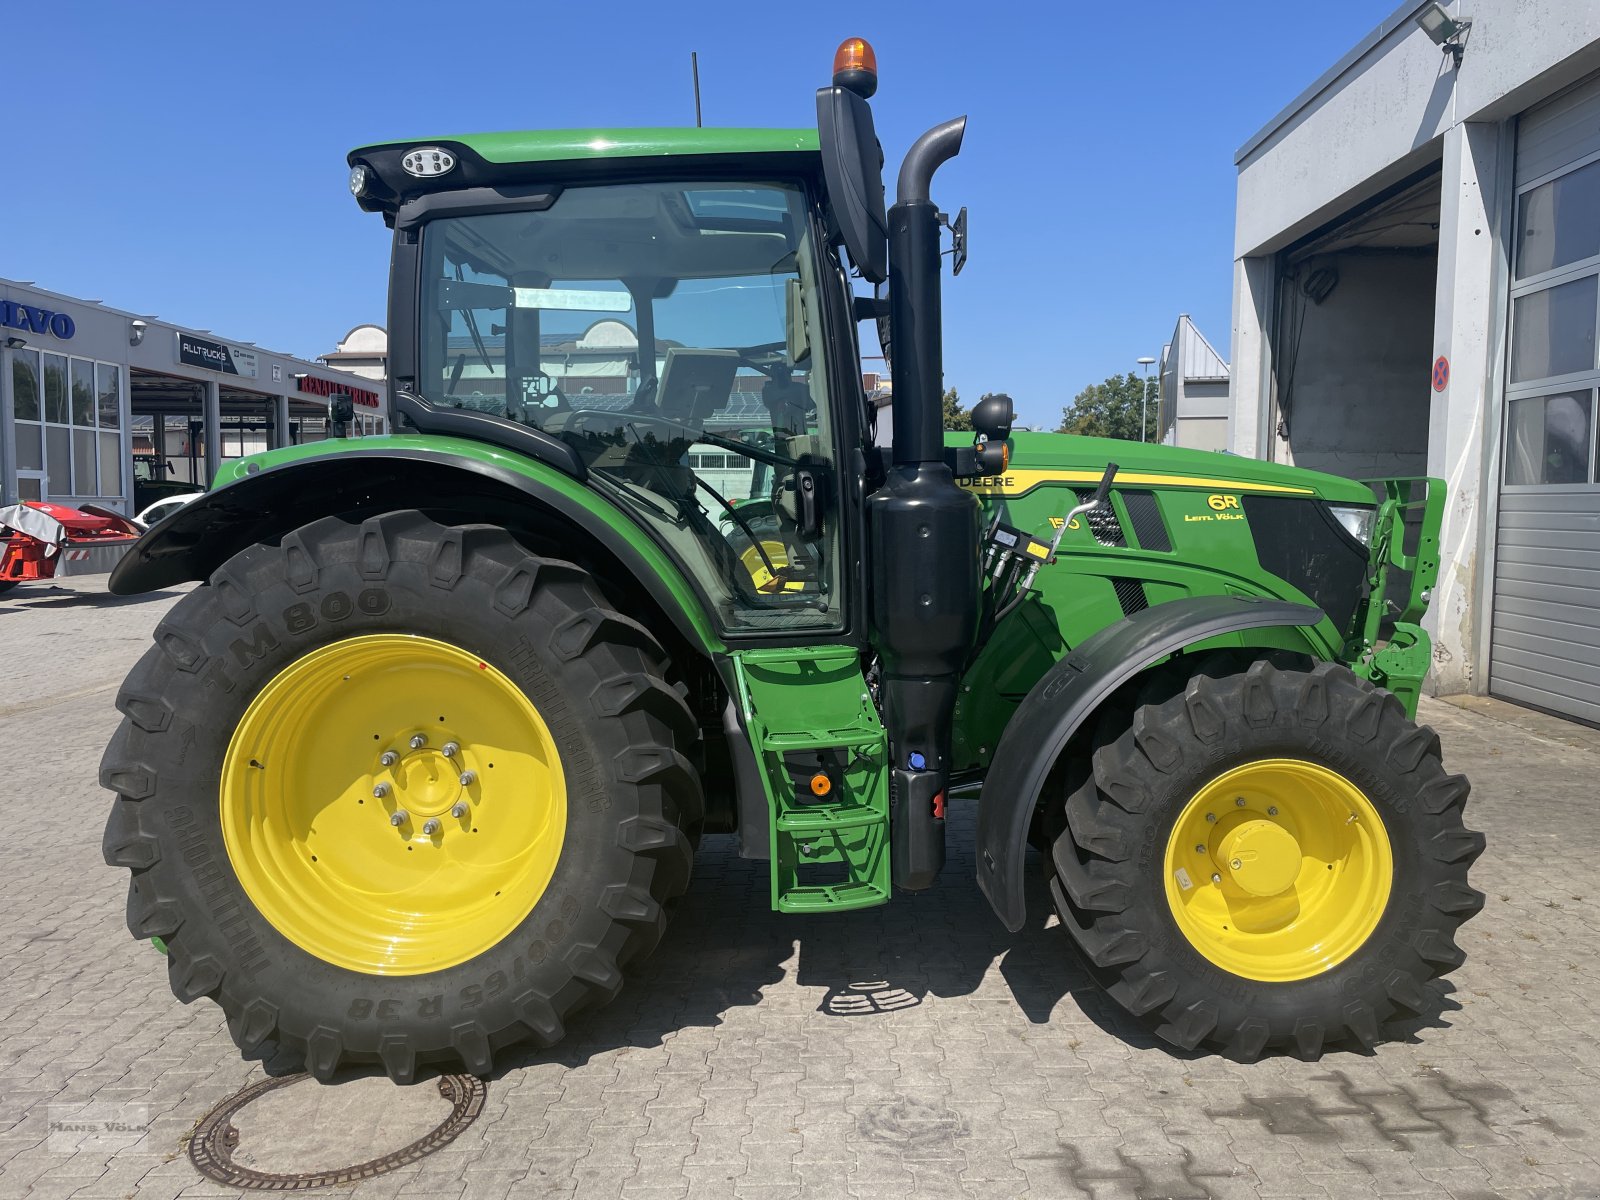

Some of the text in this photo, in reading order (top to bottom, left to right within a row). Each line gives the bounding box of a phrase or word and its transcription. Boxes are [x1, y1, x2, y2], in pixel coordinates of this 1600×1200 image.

[183, 343, 226, 361] ALLTRUCKS
[960, 477, 1014, 487] DEERE
[1207, 494, 1239, 511] 6R
[206, 588, 391, 693] TM 800
[164, 805, 272, 984] TRELLEBORG
[348, 895, 581, 1020] 600/65 R 38
